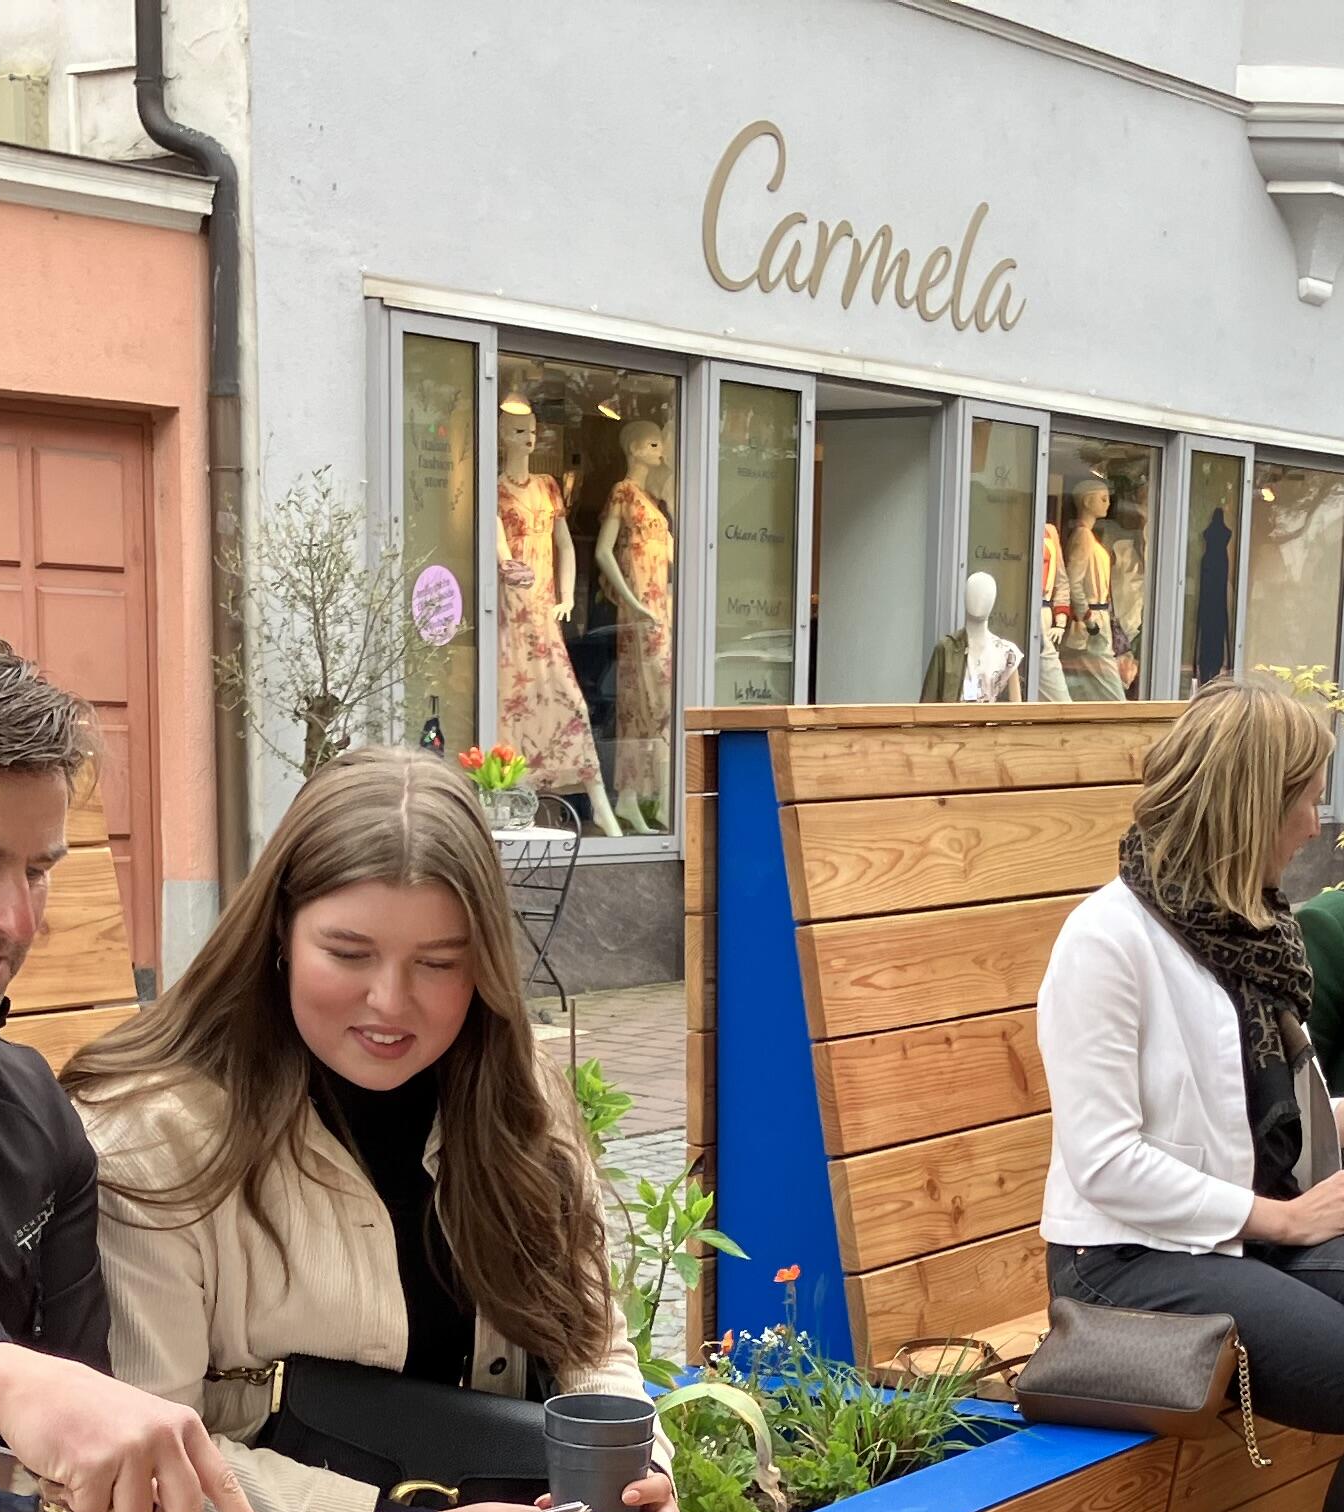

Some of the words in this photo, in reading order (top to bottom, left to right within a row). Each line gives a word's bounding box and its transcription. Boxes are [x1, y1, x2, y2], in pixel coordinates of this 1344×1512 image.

[701, 119, 1027, 333] Carmela
[418, 456, 454, 472] fashion
[424, 475, 449, 489] store
